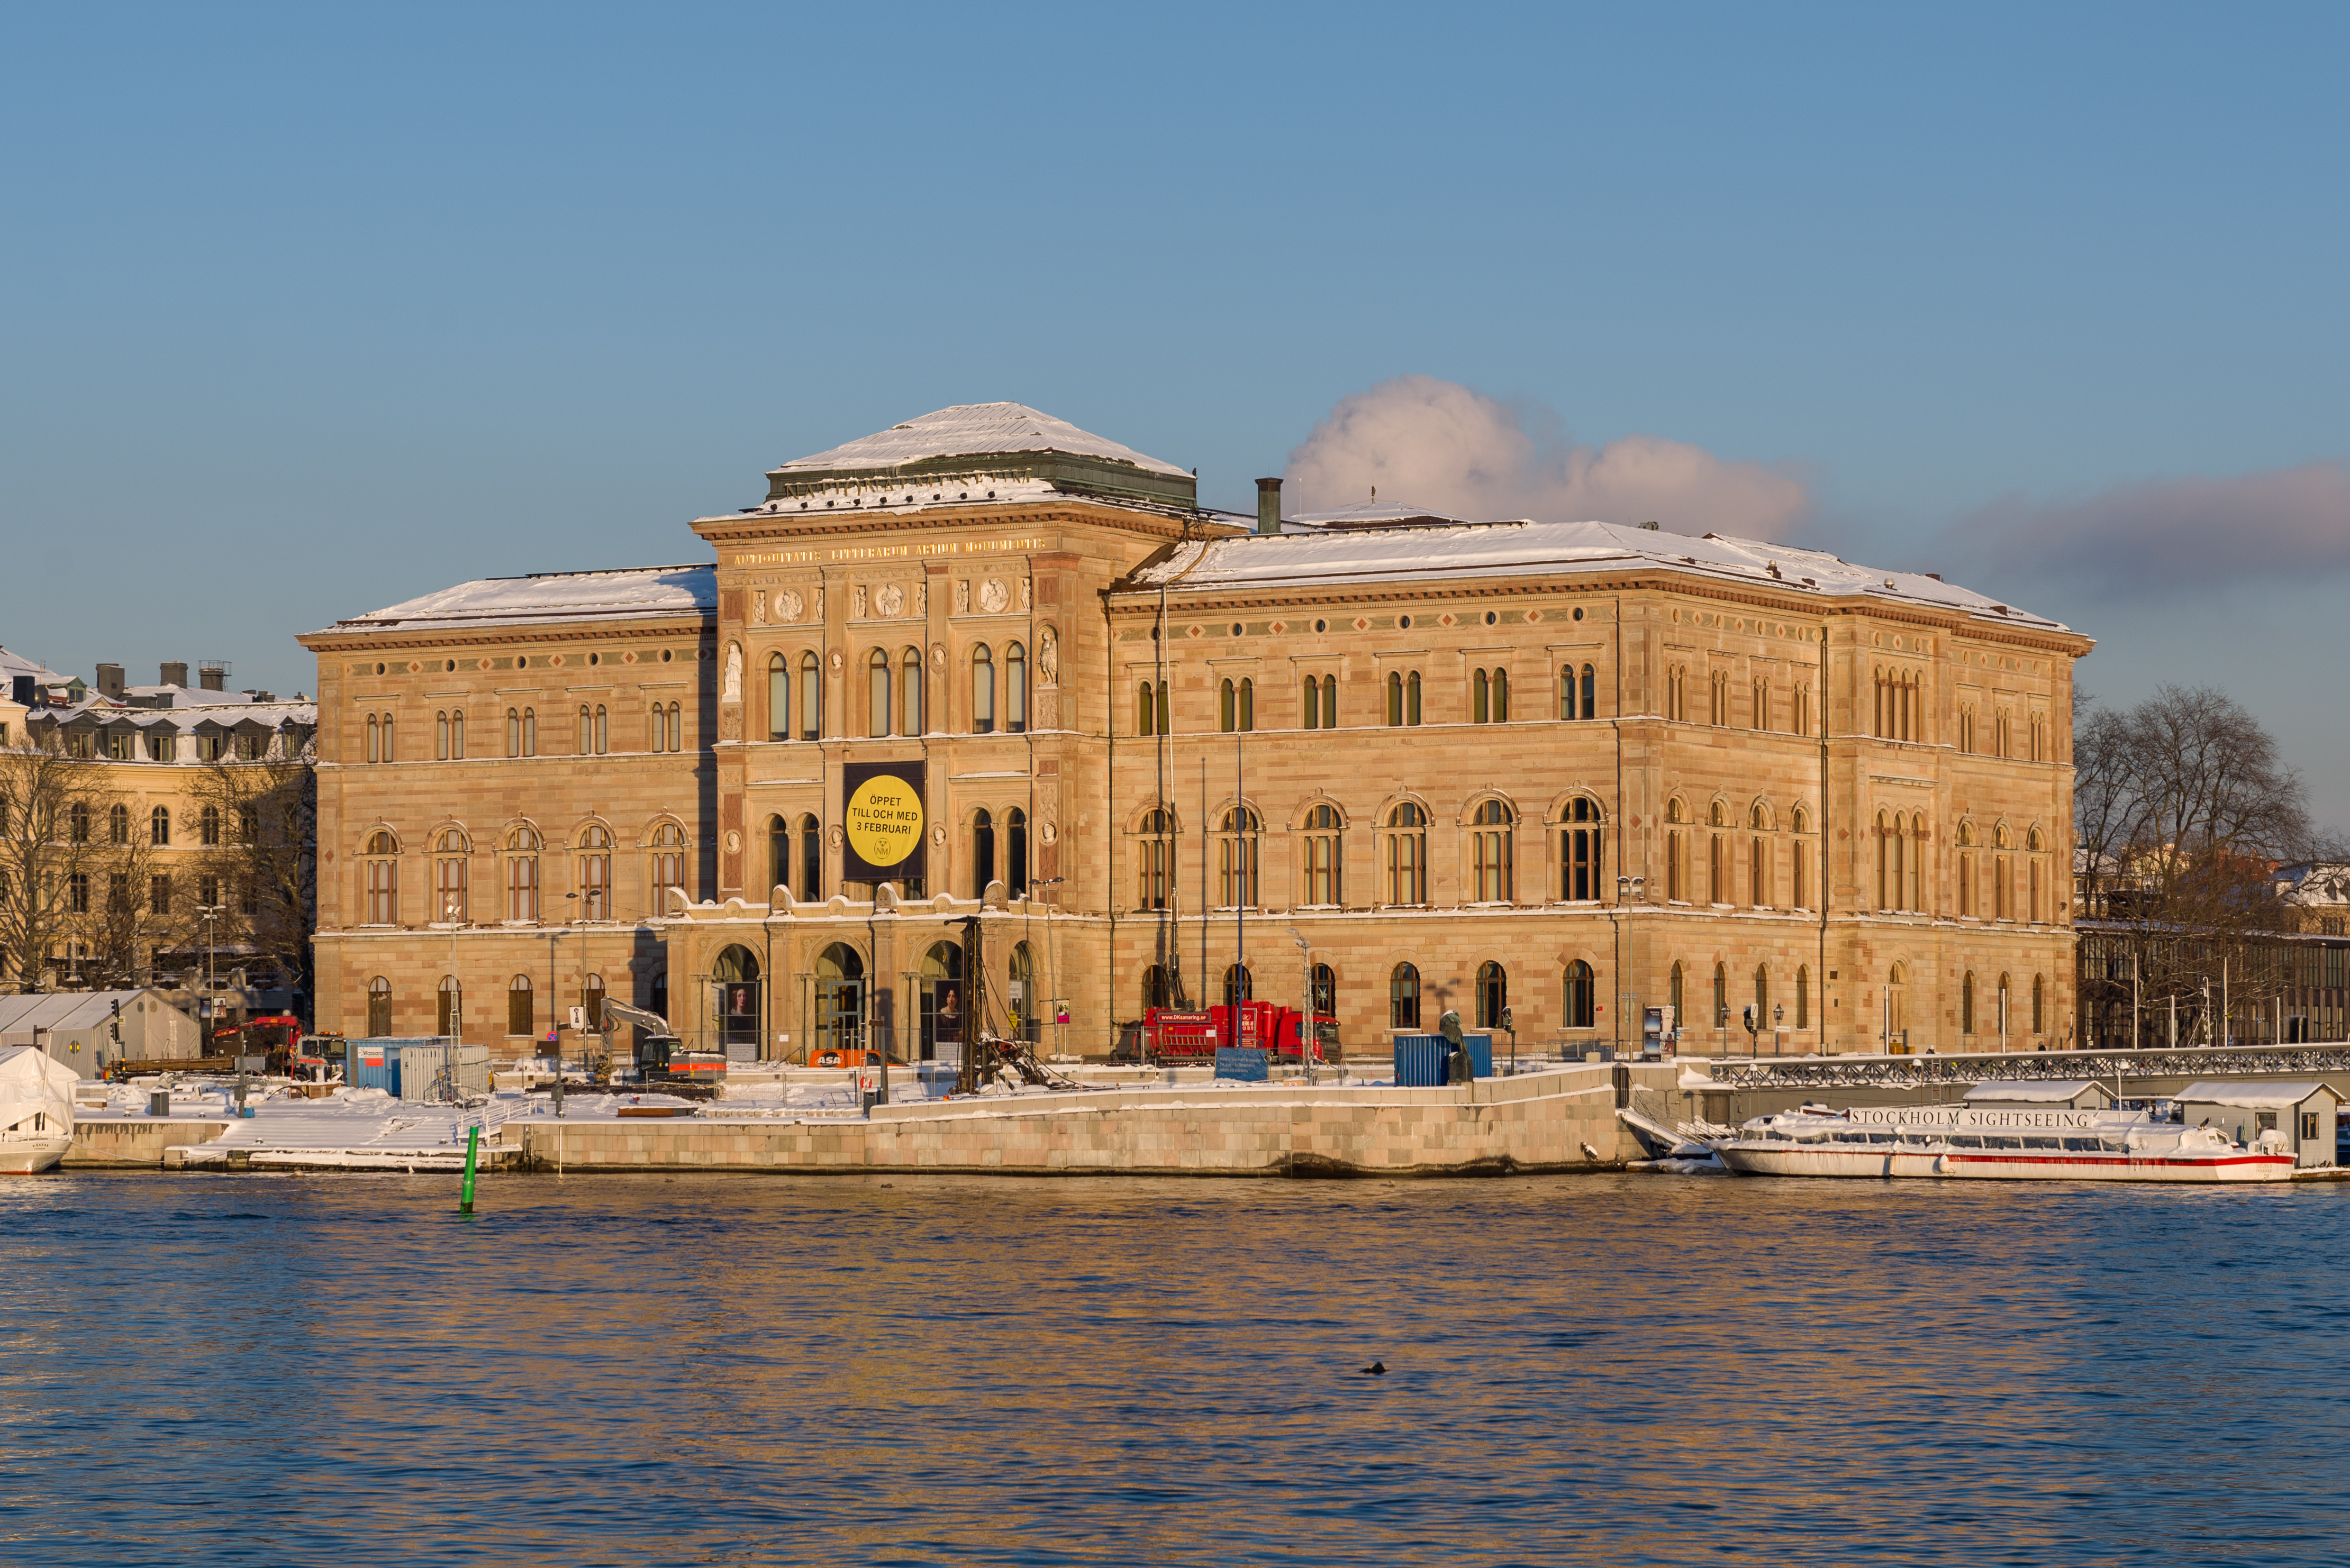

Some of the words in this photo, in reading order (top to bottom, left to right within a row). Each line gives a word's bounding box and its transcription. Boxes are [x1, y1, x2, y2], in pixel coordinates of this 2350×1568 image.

[916, 542, 956, 555] ARTIUM
[966, 538, 1045, 552] MONUMENTIS
[870, 794, 901, 806] ÖPPET
[852, 807, 870, 817] TILL
[873, 809, 893, 819] OCH
[897, 811, 918, 821] MED
[857, 822, 861, 831] 3
[865, 823, 911, 834] FEBRUARI
[1852, 1110, 1960, 1125] STOCKHOLM
[1970, 1112, 2088, 1127] SIGHTSEEING
